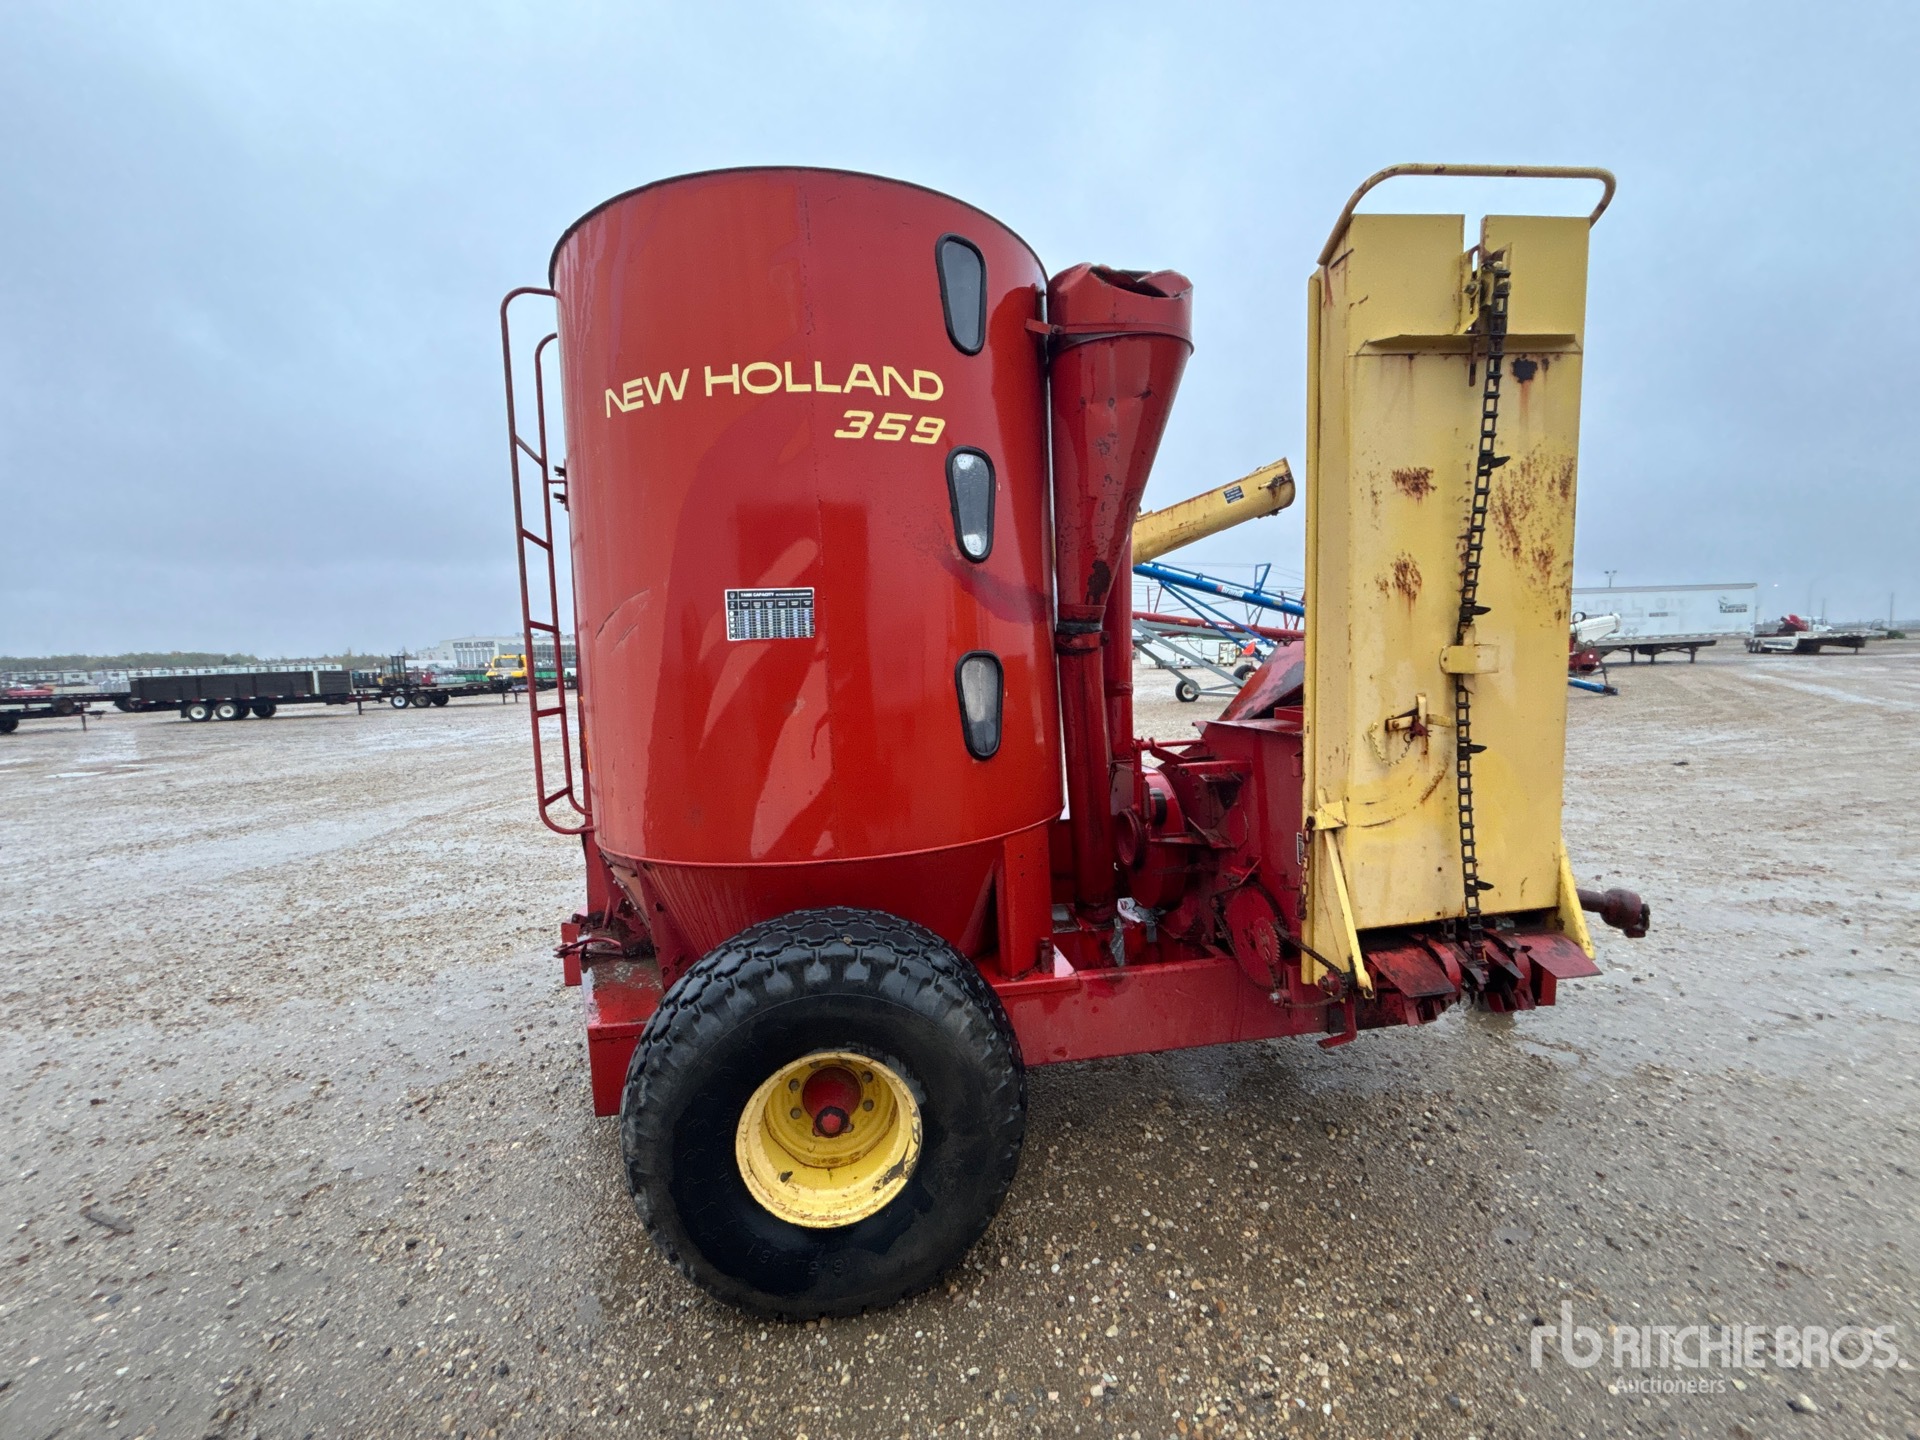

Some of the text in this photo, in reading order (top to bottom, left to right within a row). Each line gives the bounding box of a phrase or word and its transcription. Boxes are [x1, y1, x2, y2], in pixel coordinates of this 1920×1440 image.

[605, 361, 944, 418] NEW HOLLAND
[834, 410, 946, 444] 359
